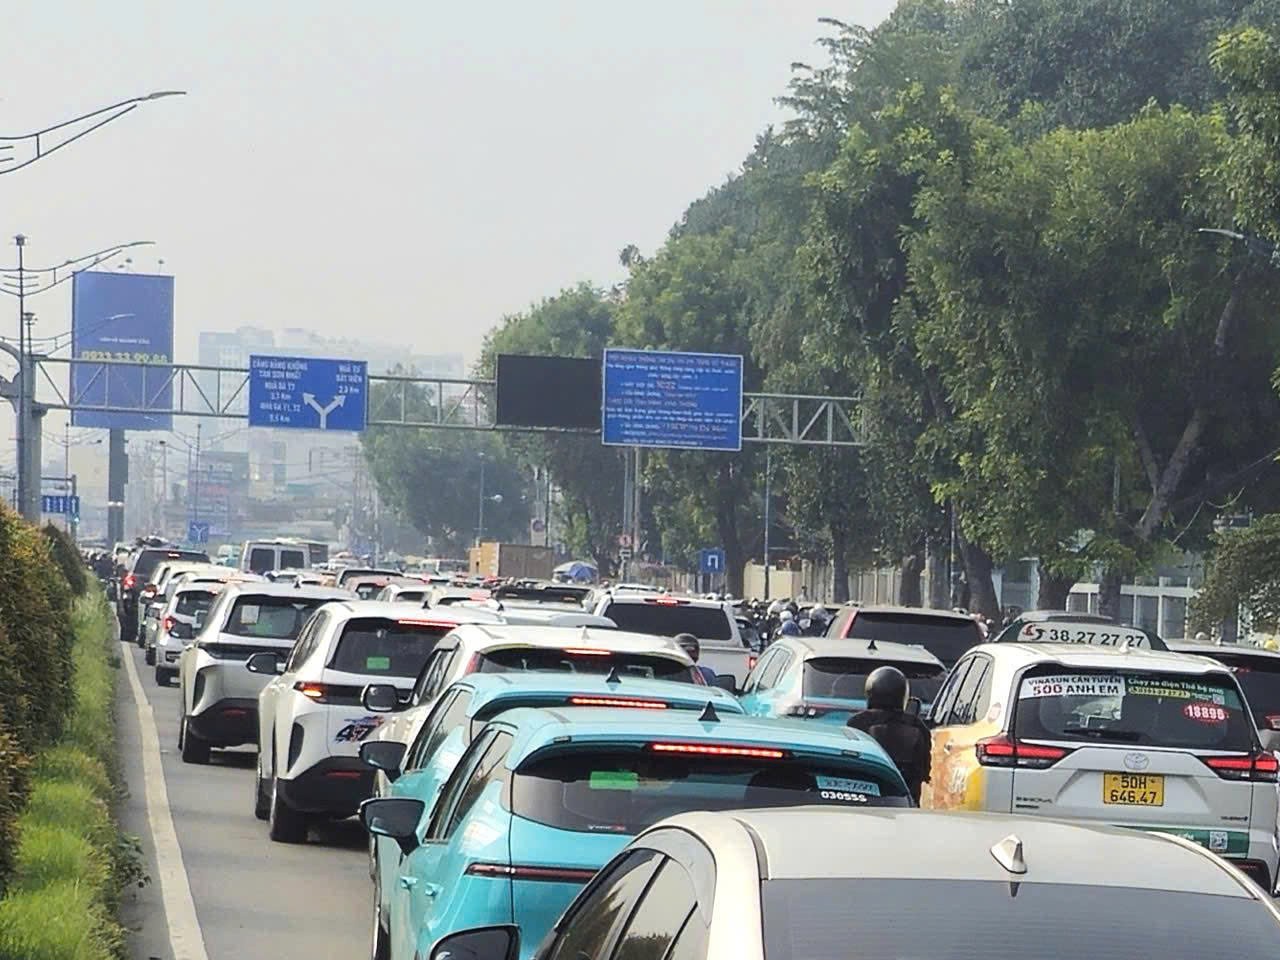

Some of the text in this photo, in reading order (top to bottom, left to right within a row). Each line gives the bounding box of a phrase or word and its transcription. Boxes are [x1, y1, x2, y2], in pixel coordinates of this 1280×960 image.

[1028, 677, 1070, 686] VINASUN
[1066, 685, 1095, 694] ANH
[1099, 685, 1119, 694] EM
[1110, 789, 1157, 804] 646.47
